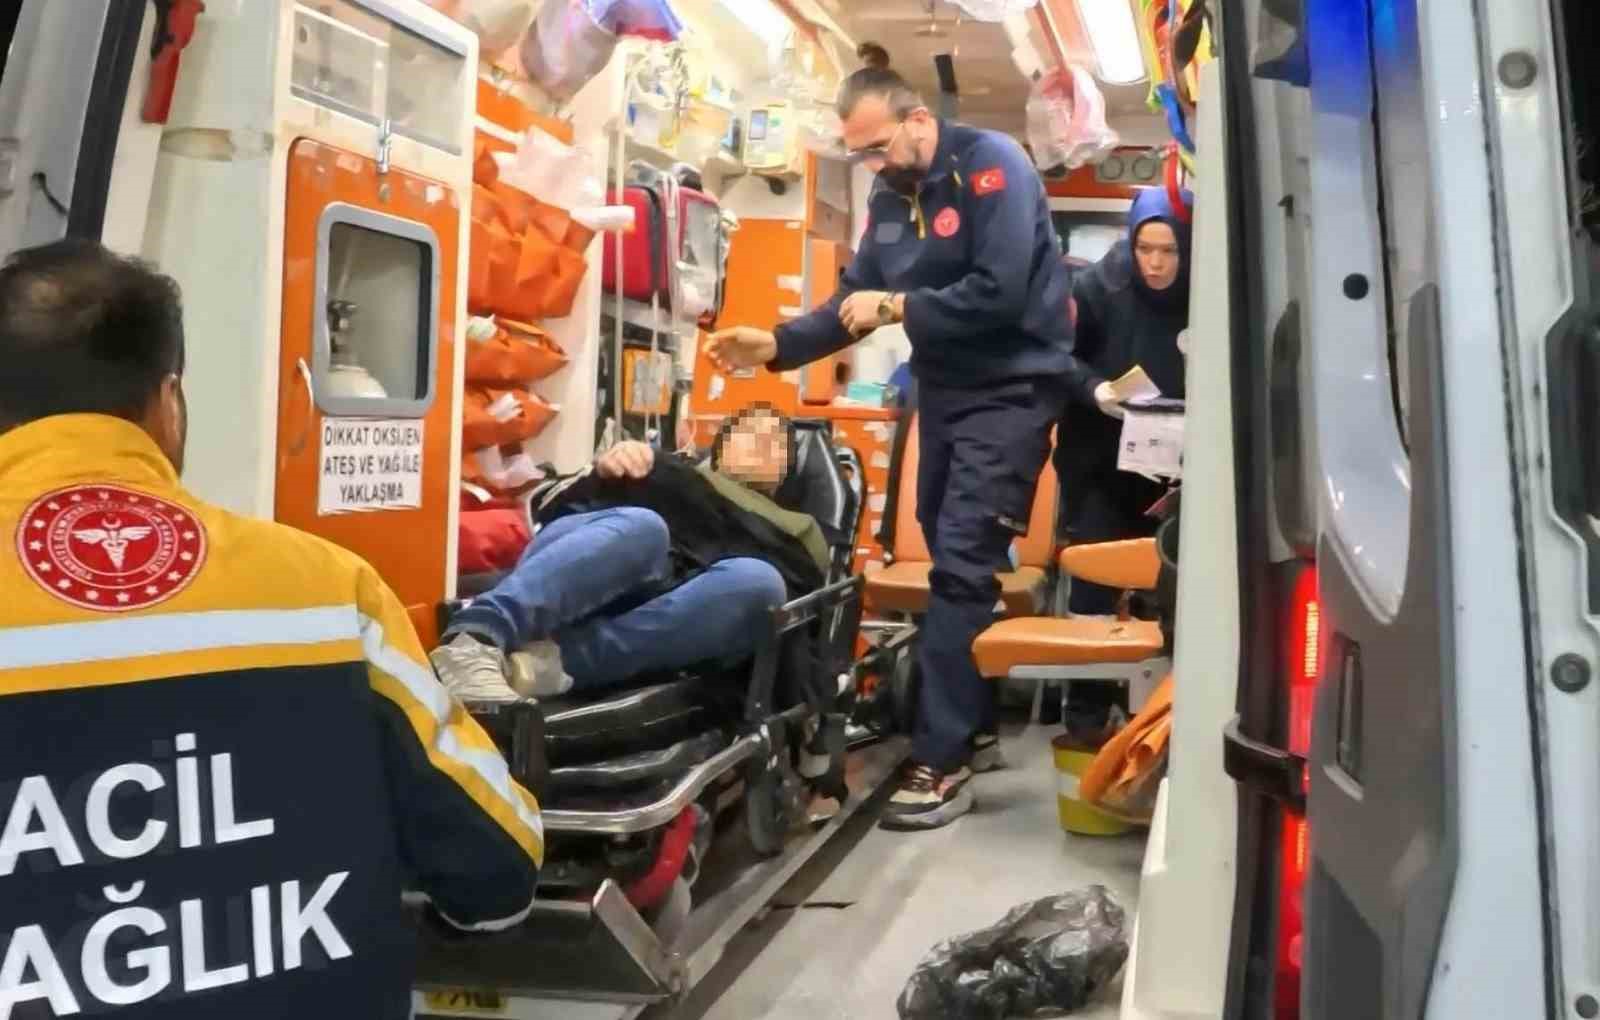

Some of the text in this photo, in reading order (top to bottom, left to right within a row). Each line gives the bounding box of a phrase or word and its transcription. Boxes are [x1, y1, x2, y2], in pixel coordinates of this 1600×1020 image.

[360, 455, 373, 474] VE
[340, 482, 403, 504] YAKLAŞMA
[0, 733, 274, 876] ACİL
